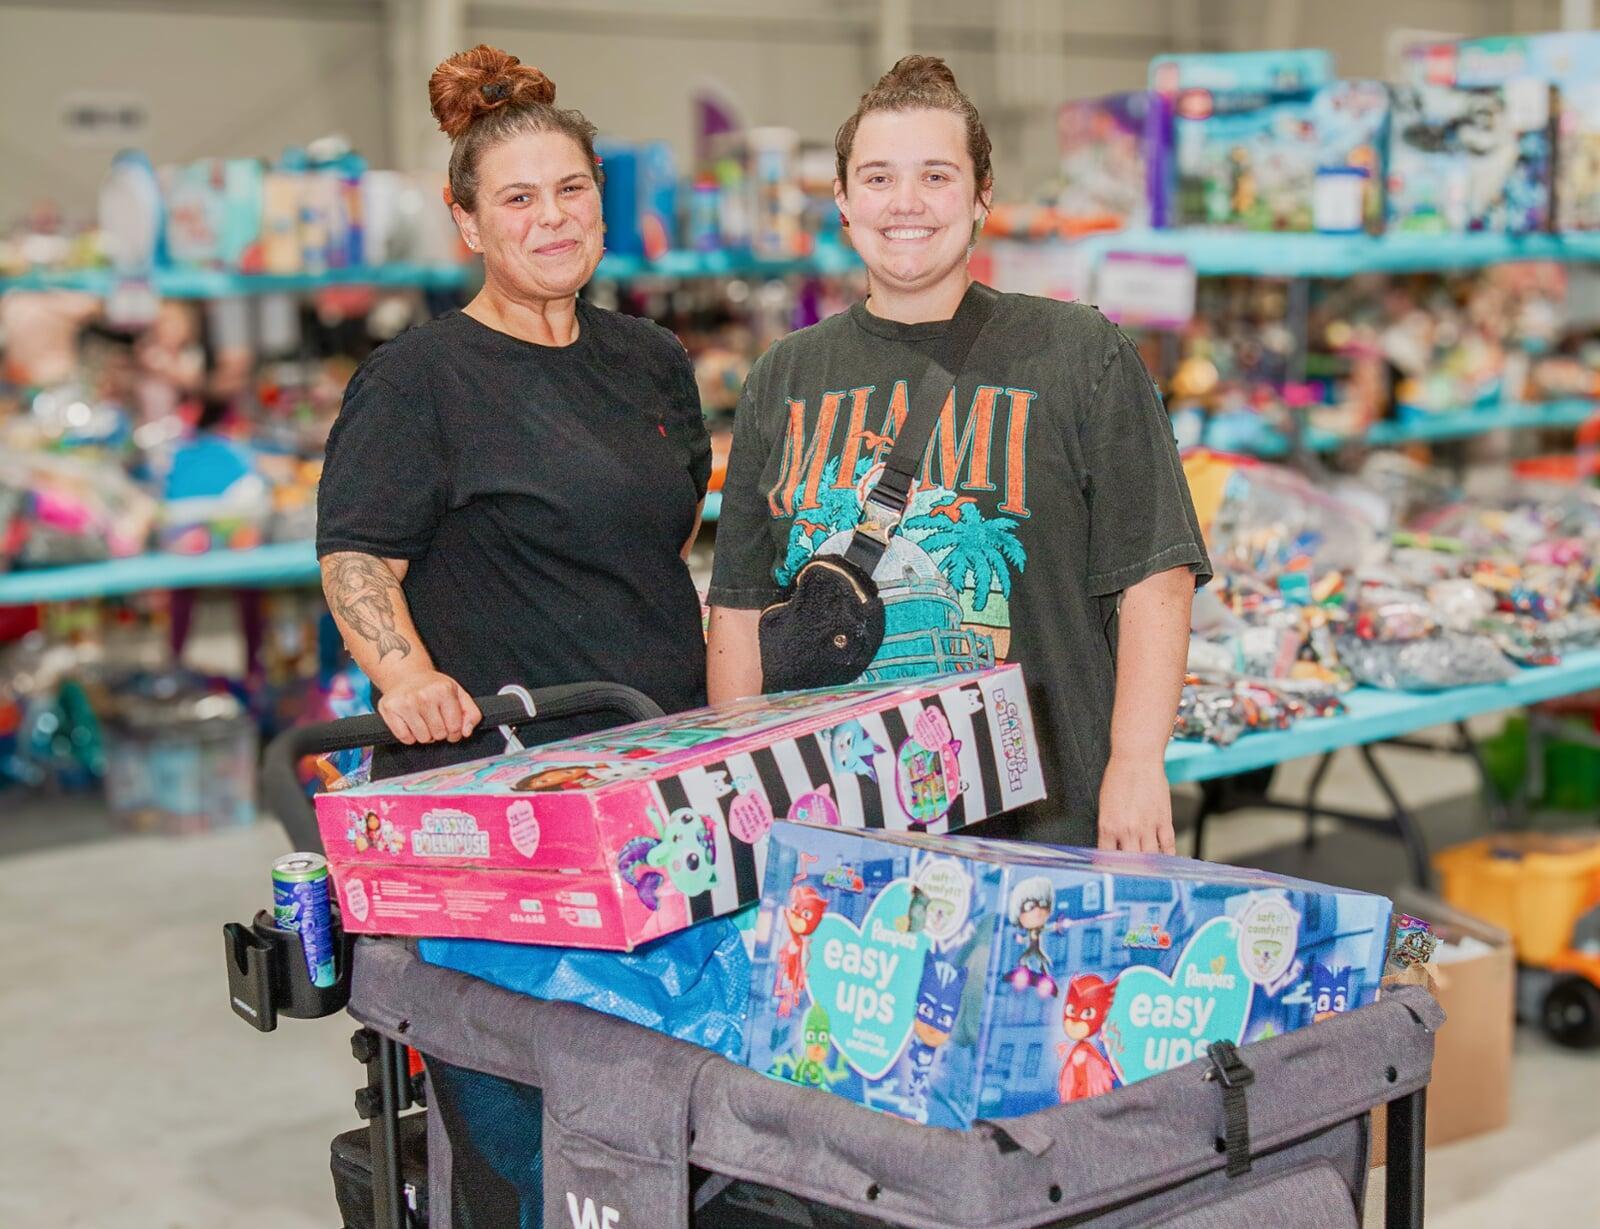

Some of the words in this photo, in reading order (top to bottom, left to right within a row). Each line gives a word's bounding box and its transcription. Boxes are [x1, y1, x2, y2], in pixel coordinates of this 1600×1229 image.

[993, 688, 1022, 792] DOLLHOUSE
[1007, 702, 1028, 774] GABBY'S
[413, 832, 489, 856] DOLLHOUSE
[423, 813, 477, 833] GABBY'S
[1257, 911, 1276, 922] soft
[823, 938, 899, 989] easy
[1185, 963, 1236, 992] Pampers
[836, 980, 897, 1025] ups
[1129, 993, 1216, 1037] easy
